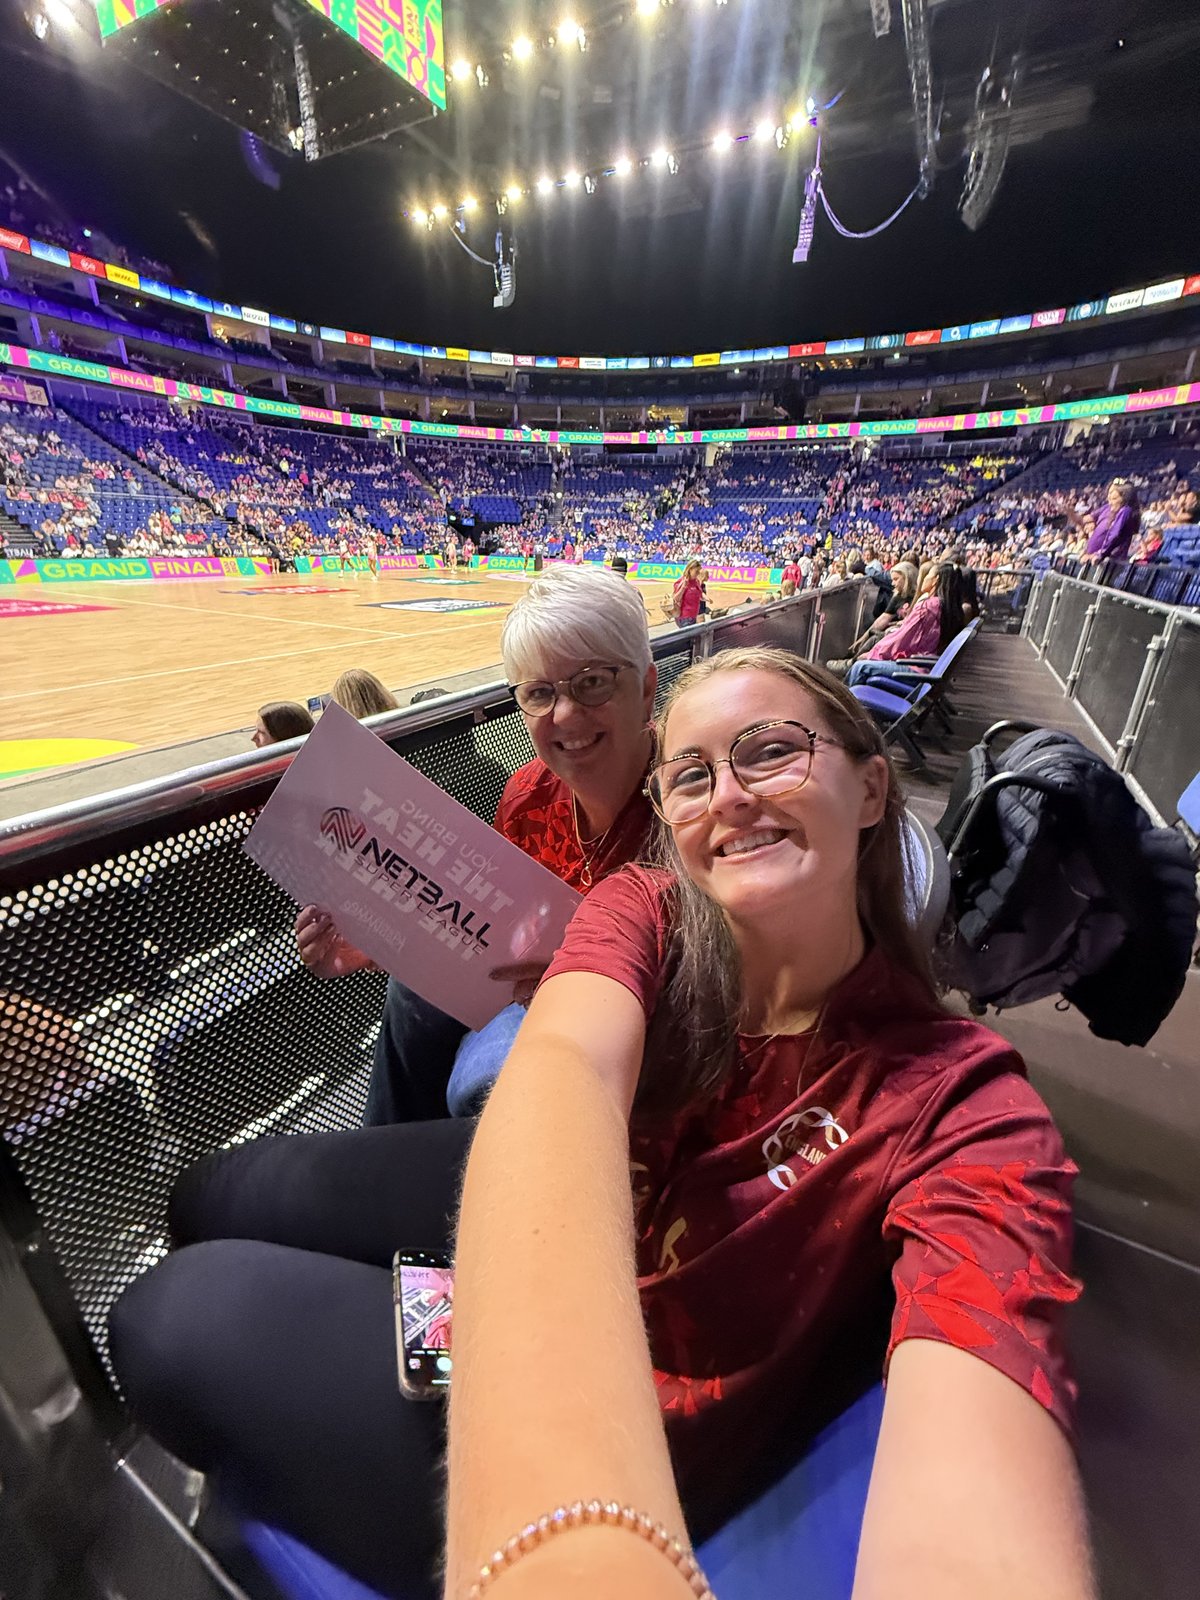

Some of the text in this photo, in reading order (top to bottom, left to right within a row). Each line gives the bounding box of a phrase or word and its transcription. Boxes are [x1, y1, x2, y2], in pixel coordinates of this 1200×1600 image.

[48, 359, 153, 388] GRAND FINAL
[258, 402, 332, 420] GRAND FINAL
[1070, 393, 1173, 414] GRAND FINAL
[421, 425, 487, 437] GRAND FINAL
[873, 420, 952, 432] GRAND FINAL
[711, 431, 746, 440] GRAND
[42, 561, 221, 578] GRAND FINAL
[380, 559, 417, 568] FINAL
[640, 565, 685, 576] GRAN
[361, 837, 491, 948] NETBALL
[354, 854, 486, 956] SUPER LEAGUE
